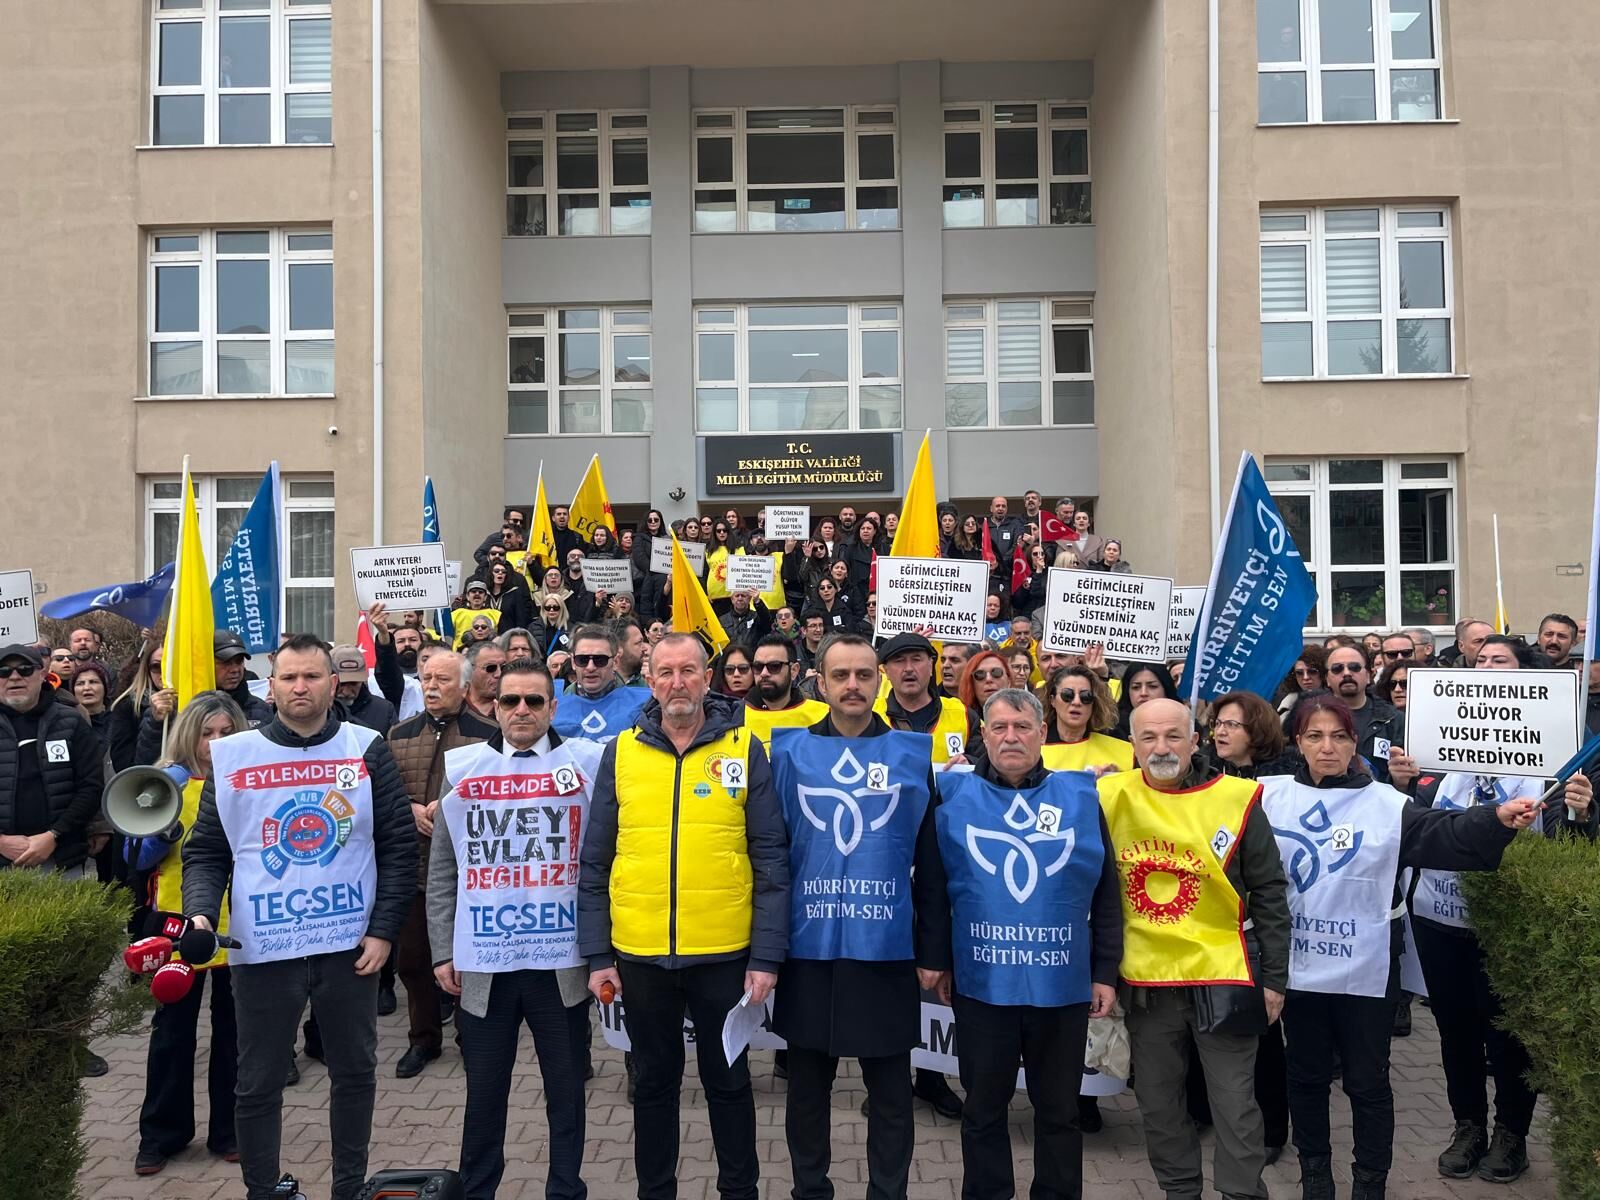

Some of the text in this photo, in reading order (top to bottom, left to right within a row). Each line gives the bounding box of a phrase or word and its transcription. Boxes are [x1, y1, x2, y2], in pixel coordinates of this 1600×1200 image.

[738, 456, 861, 470] ESKİŞEHİR VALİLİĞİ
[716, 470, 883, 485] MİLLİ EĞİTİM MÜDÜRLÜĞÜ
[374, 556, 422, 566] ARTIK YETER!
[358, 568, 410, 578] OKULLARIMIZI
[412, 565, 442, 577] ŞİDDETE
[900, 564, 960, 578] EĞİTİMCİLERİ
[387, 578, 414, 588] TESLİM
[889, 578, 972, 593] DEĞERSİZLEŞTİREN
[1077, 578, 1144, 594] EĞİTİMCİLERİ
[375, 589, 427, 600] ETMEYECEĞİZ!
[902, 592, 954, 606] SİSTEMİNİZ
[1063, 592, 1155, 611] DEĞERSİZLEŞTİREN
[883, 604, 976, 624] YÜZÜNDEN DAHA KAÇ
[1080, 608, 1136, 624] SİSTEMİNİZ
[1054, 620, 1160, 644] YÜZÜNDEN DAHA KAÇ
[1213, 564, 1289, 695] EĞİTİM SEN
[1106, 639, 1160, 656] ÖLECEK???
[1433, 680, 1548, 700] ÖĞRETMENLER
[1457, 702, 1522, 721] ÖLÜYOR
[1439, 726, 1541, 744] YUSUF TEKİN
[1438, 746, 1544, 767] SEYREDİYOR!
[300, 792, 318, 802] A/B
[328, 796, 347, 816] YHS
[466, 804, 568, 839] ÜVEY
[265, 824, 276, 844] SHS
[340, 822, 350, 841] THS
[467, 836, 566, 865] EVLAT
[803, 875, 896, 900] HÜRRİYETÇİ
[249, 880, 364, 925] TEÇ-SEN
[806, 900, 893, 920] EĞİTİM-SEN
[469, 900, 575, 939] TEÇ-SEN
[970, 921, 1072, 946] HÜRRİYETÇİ
[973, 944, 1070, 966] EĞİTİM-SEN
